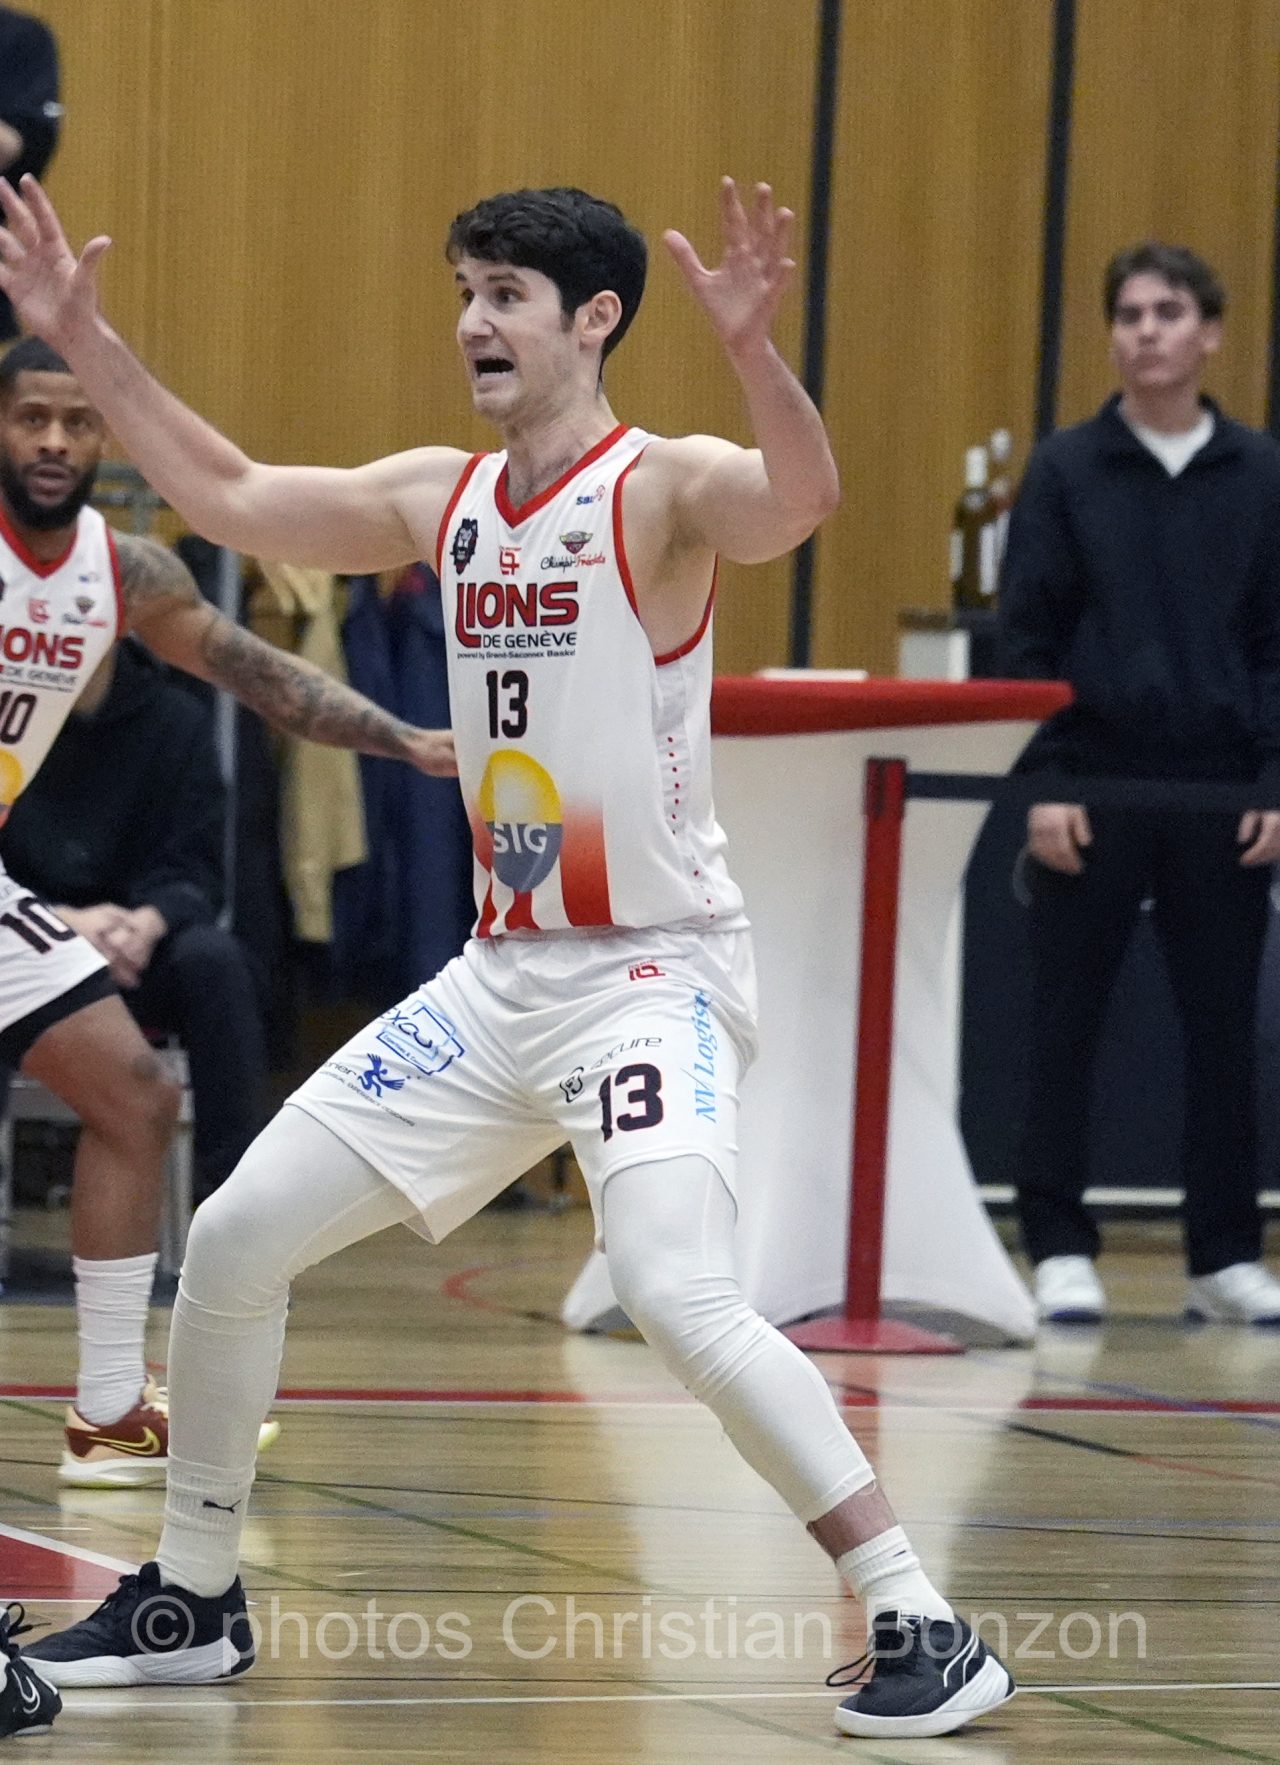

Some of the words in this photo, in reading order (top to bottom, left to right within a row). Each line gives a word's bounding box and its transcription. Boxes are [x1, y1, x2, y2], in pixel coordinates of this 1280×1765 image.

[455, 582, 580, 648] LIONS
[483, 634, 501, 648] DE
[505, 630, 577, 648] GENÈVE
[486, 670, 529, 738] 13
[493, 823, 548, 854] SIG
[598, 1063, 663, 1142] 13
